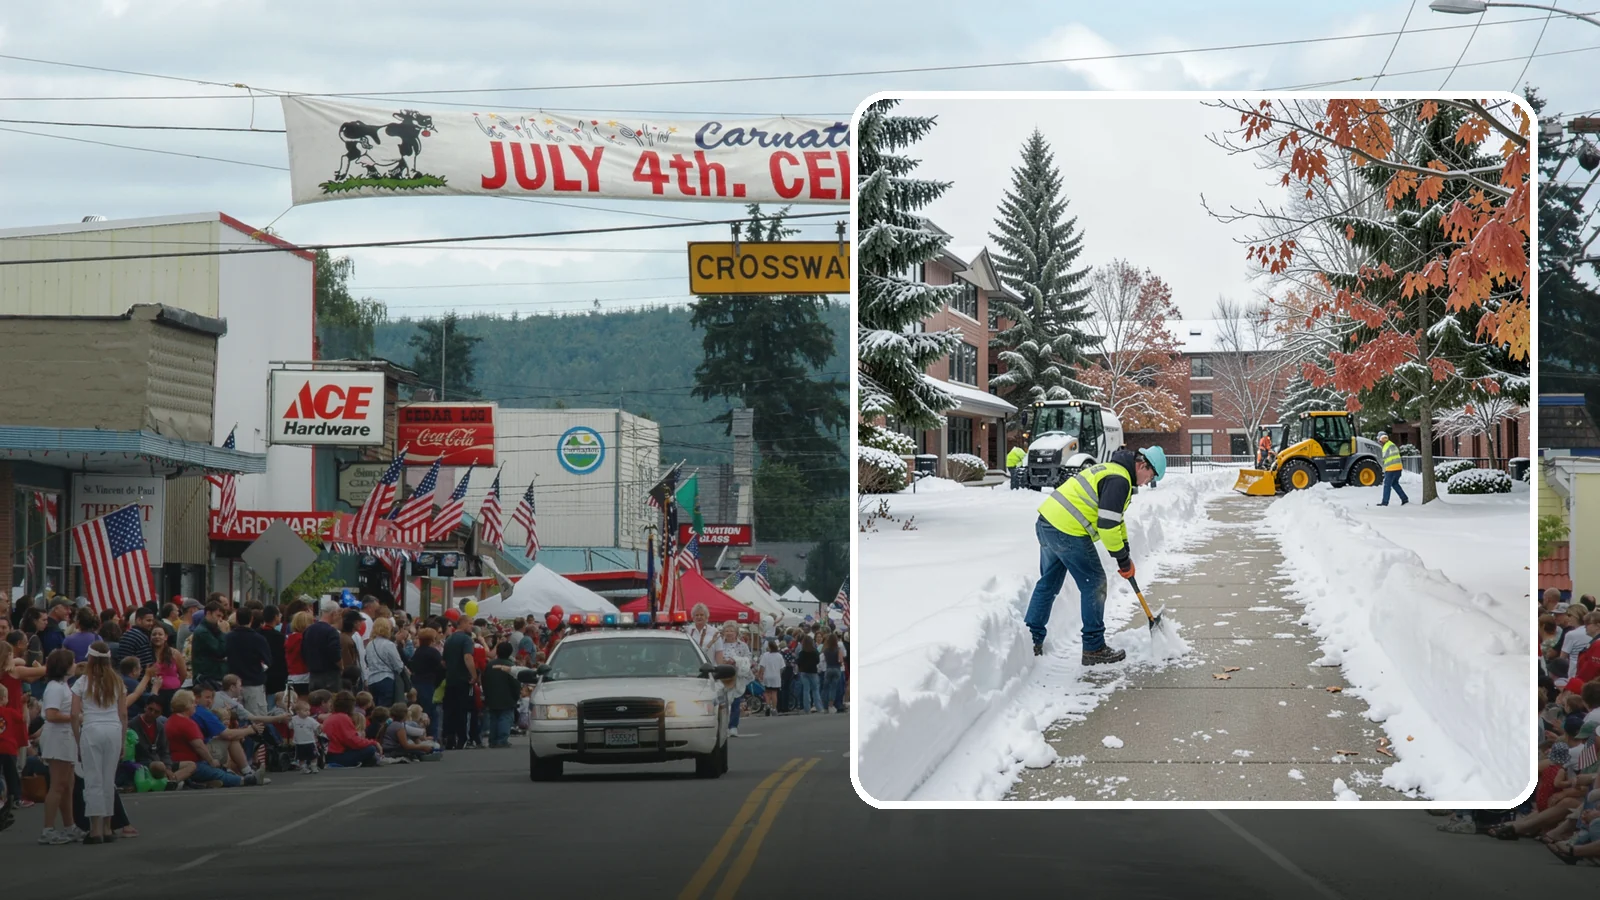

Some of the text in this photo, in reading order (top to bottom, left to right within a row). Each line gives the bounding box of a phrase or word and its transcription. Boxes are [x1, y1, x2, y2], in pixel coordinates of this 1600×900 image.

[695, 121, 850, 150] Carnat
[481, 141, 605, 192] JULY
[632, 149, 746, 198] 4th.
[697, 254, 850, 280] CROSSWA
[283, 380, 373, 420] ACE
[406, 409, 486, 422] CEDAR LOG
[283, 421, 371, 436] Hardware
[416, 428, 477, 447] Coca-Cola
[353, 466, 387, 481] Simpl
[96, 485, 124, 495] Vincent
[126, 486, 136, 495] de
[137, 486, 155, 495] Paul
[81, 503, 154, 522] THT
[688, 526, 741, 535] CRNATION
[699, 535, 730, 543] GLASS
